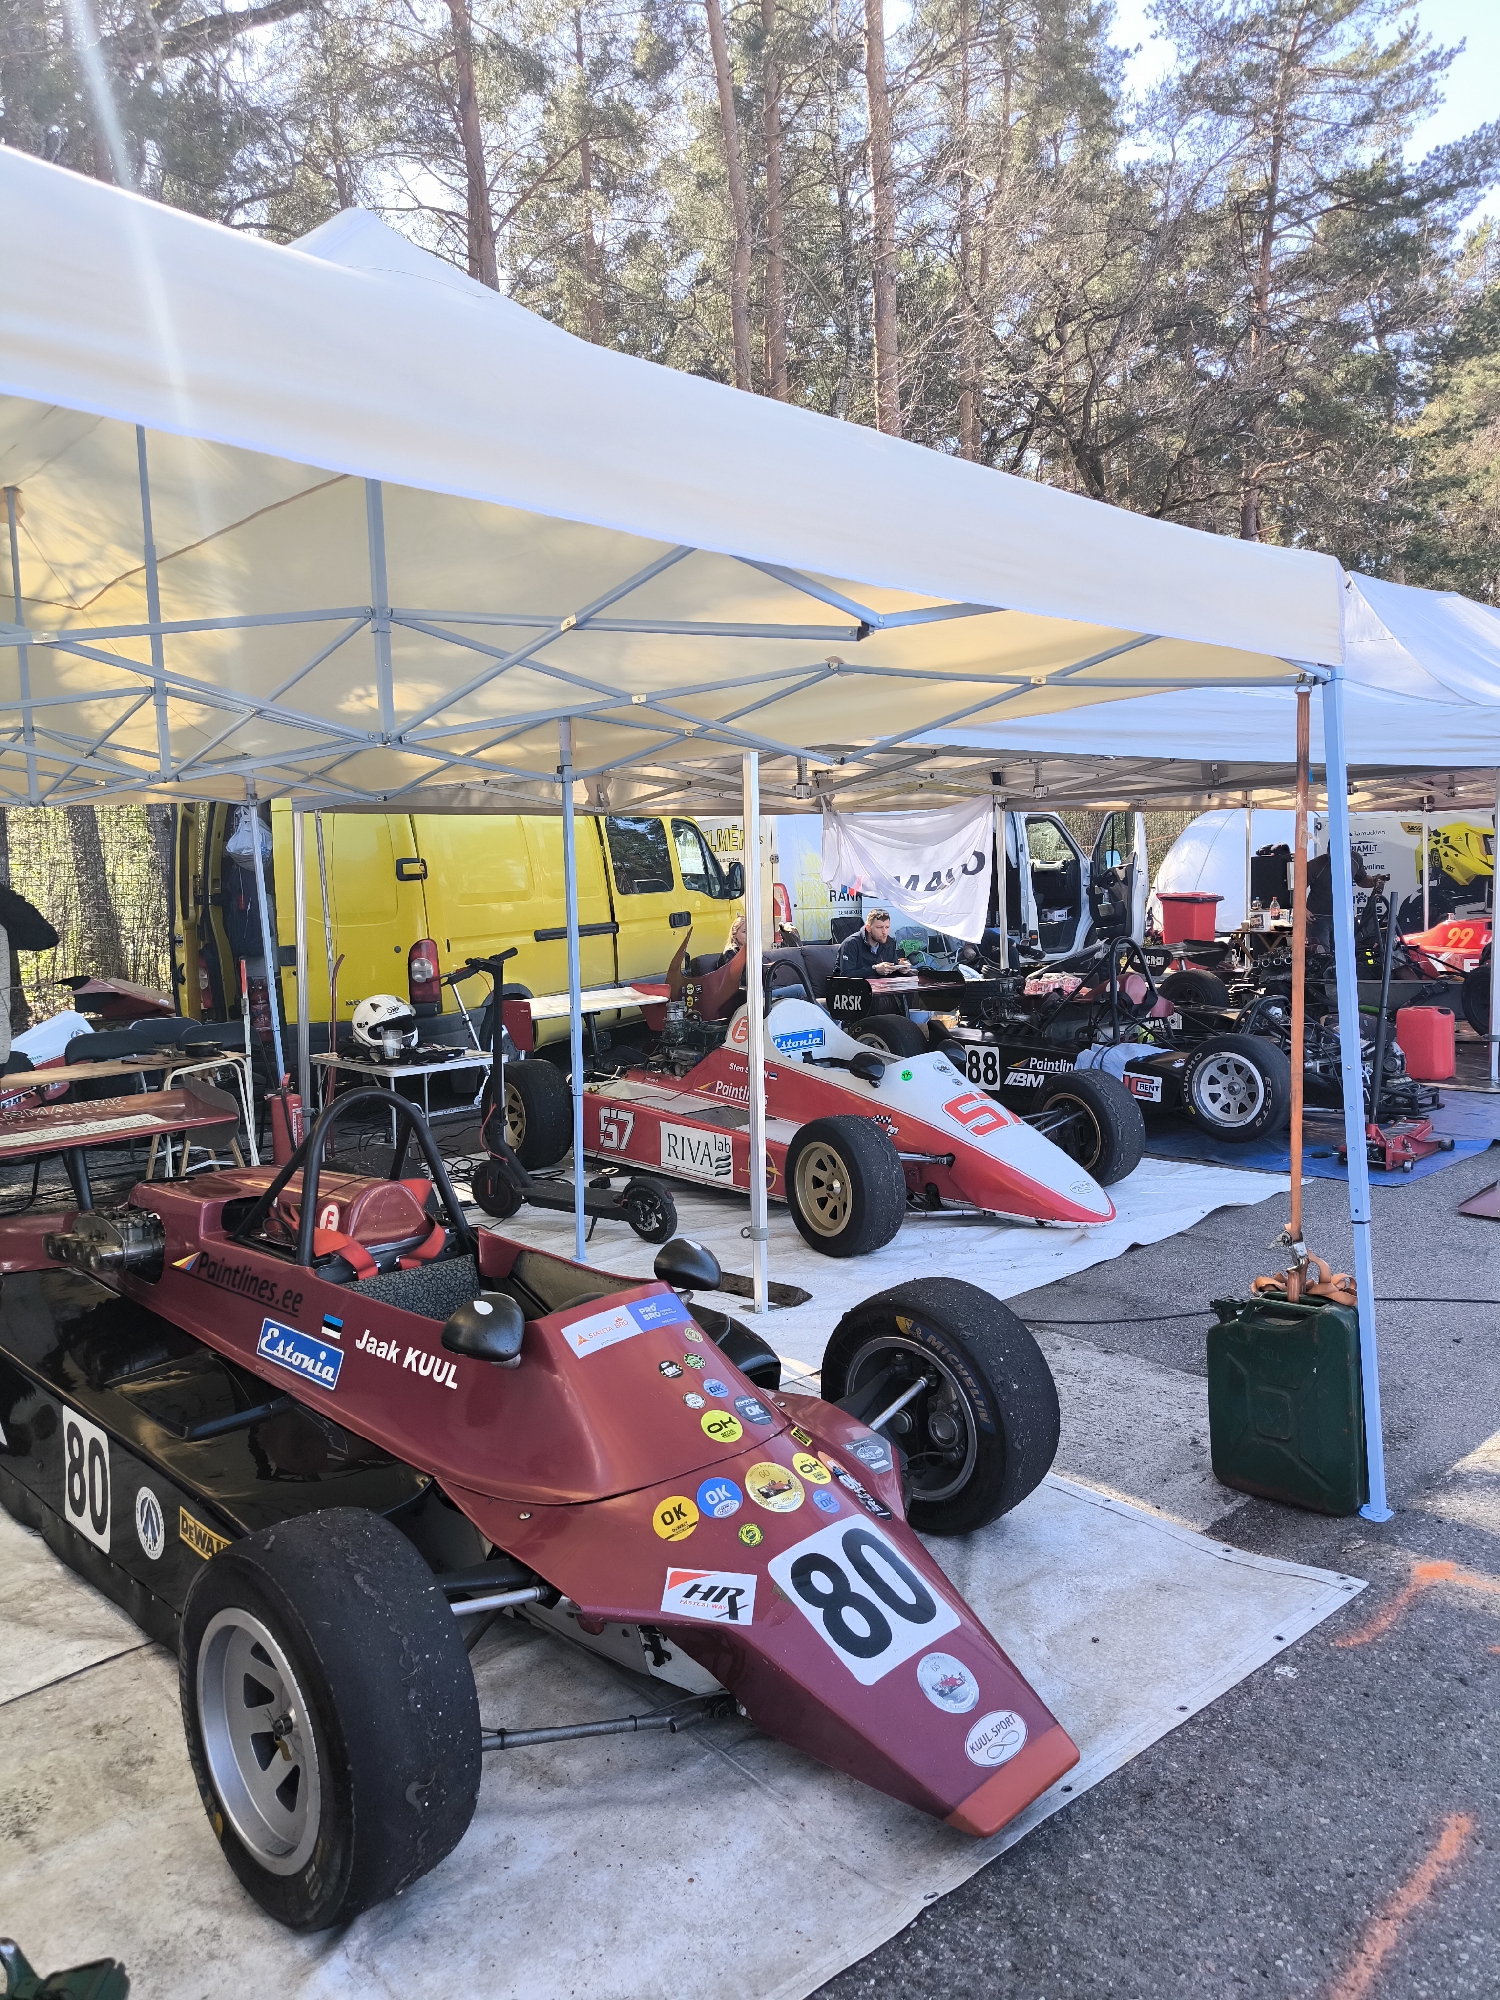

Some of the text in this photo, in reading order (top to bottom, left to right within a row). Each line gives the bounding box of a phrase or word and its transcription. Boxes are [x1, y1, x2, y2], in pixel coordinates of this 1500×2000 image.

[703, 825, 744, 852] LMĒ
[1447, 927, 1475, 948] 99
[833, 994, 862, 1011] ARSK
[967, 1050, 998, 1086] 88
[1139, 1083, 1160, 1092] RENT
[599, 1106, 635, 1151] 57
[667, 1132, 731, 1168] RIVA lab
[197, 1251, 304, 1313] Paintlines.ee
[638, 1304, 657, 1316] PRO
[643, 1311, 662, 1322] BRO
[260, 1328, 336, 1382] Estonia
[355, 1329, 458, 1390] Jaak KUUL
[708, 1383, 725, 1394] OK
[926, 1334, 992, 1425] MICHELIN
[744, 1405, 765, 1416] OK
[706, 1416, 738, 1434] OK
[66, 1420, 109, 1536] 80
[799, 1460, 824, 1474] OK
[704, 1484, 733, 1505] OK
[819, 1496, 835, 1508] OK
[660, 1502, 688, 1526] OK
[181, 1513, 232, 1557] DEWAL
[790, 1527, 937, 1659] 80
[710, 1603, 728, 1611] WAY
[990, 1713, 1017, 1738] SPORT
